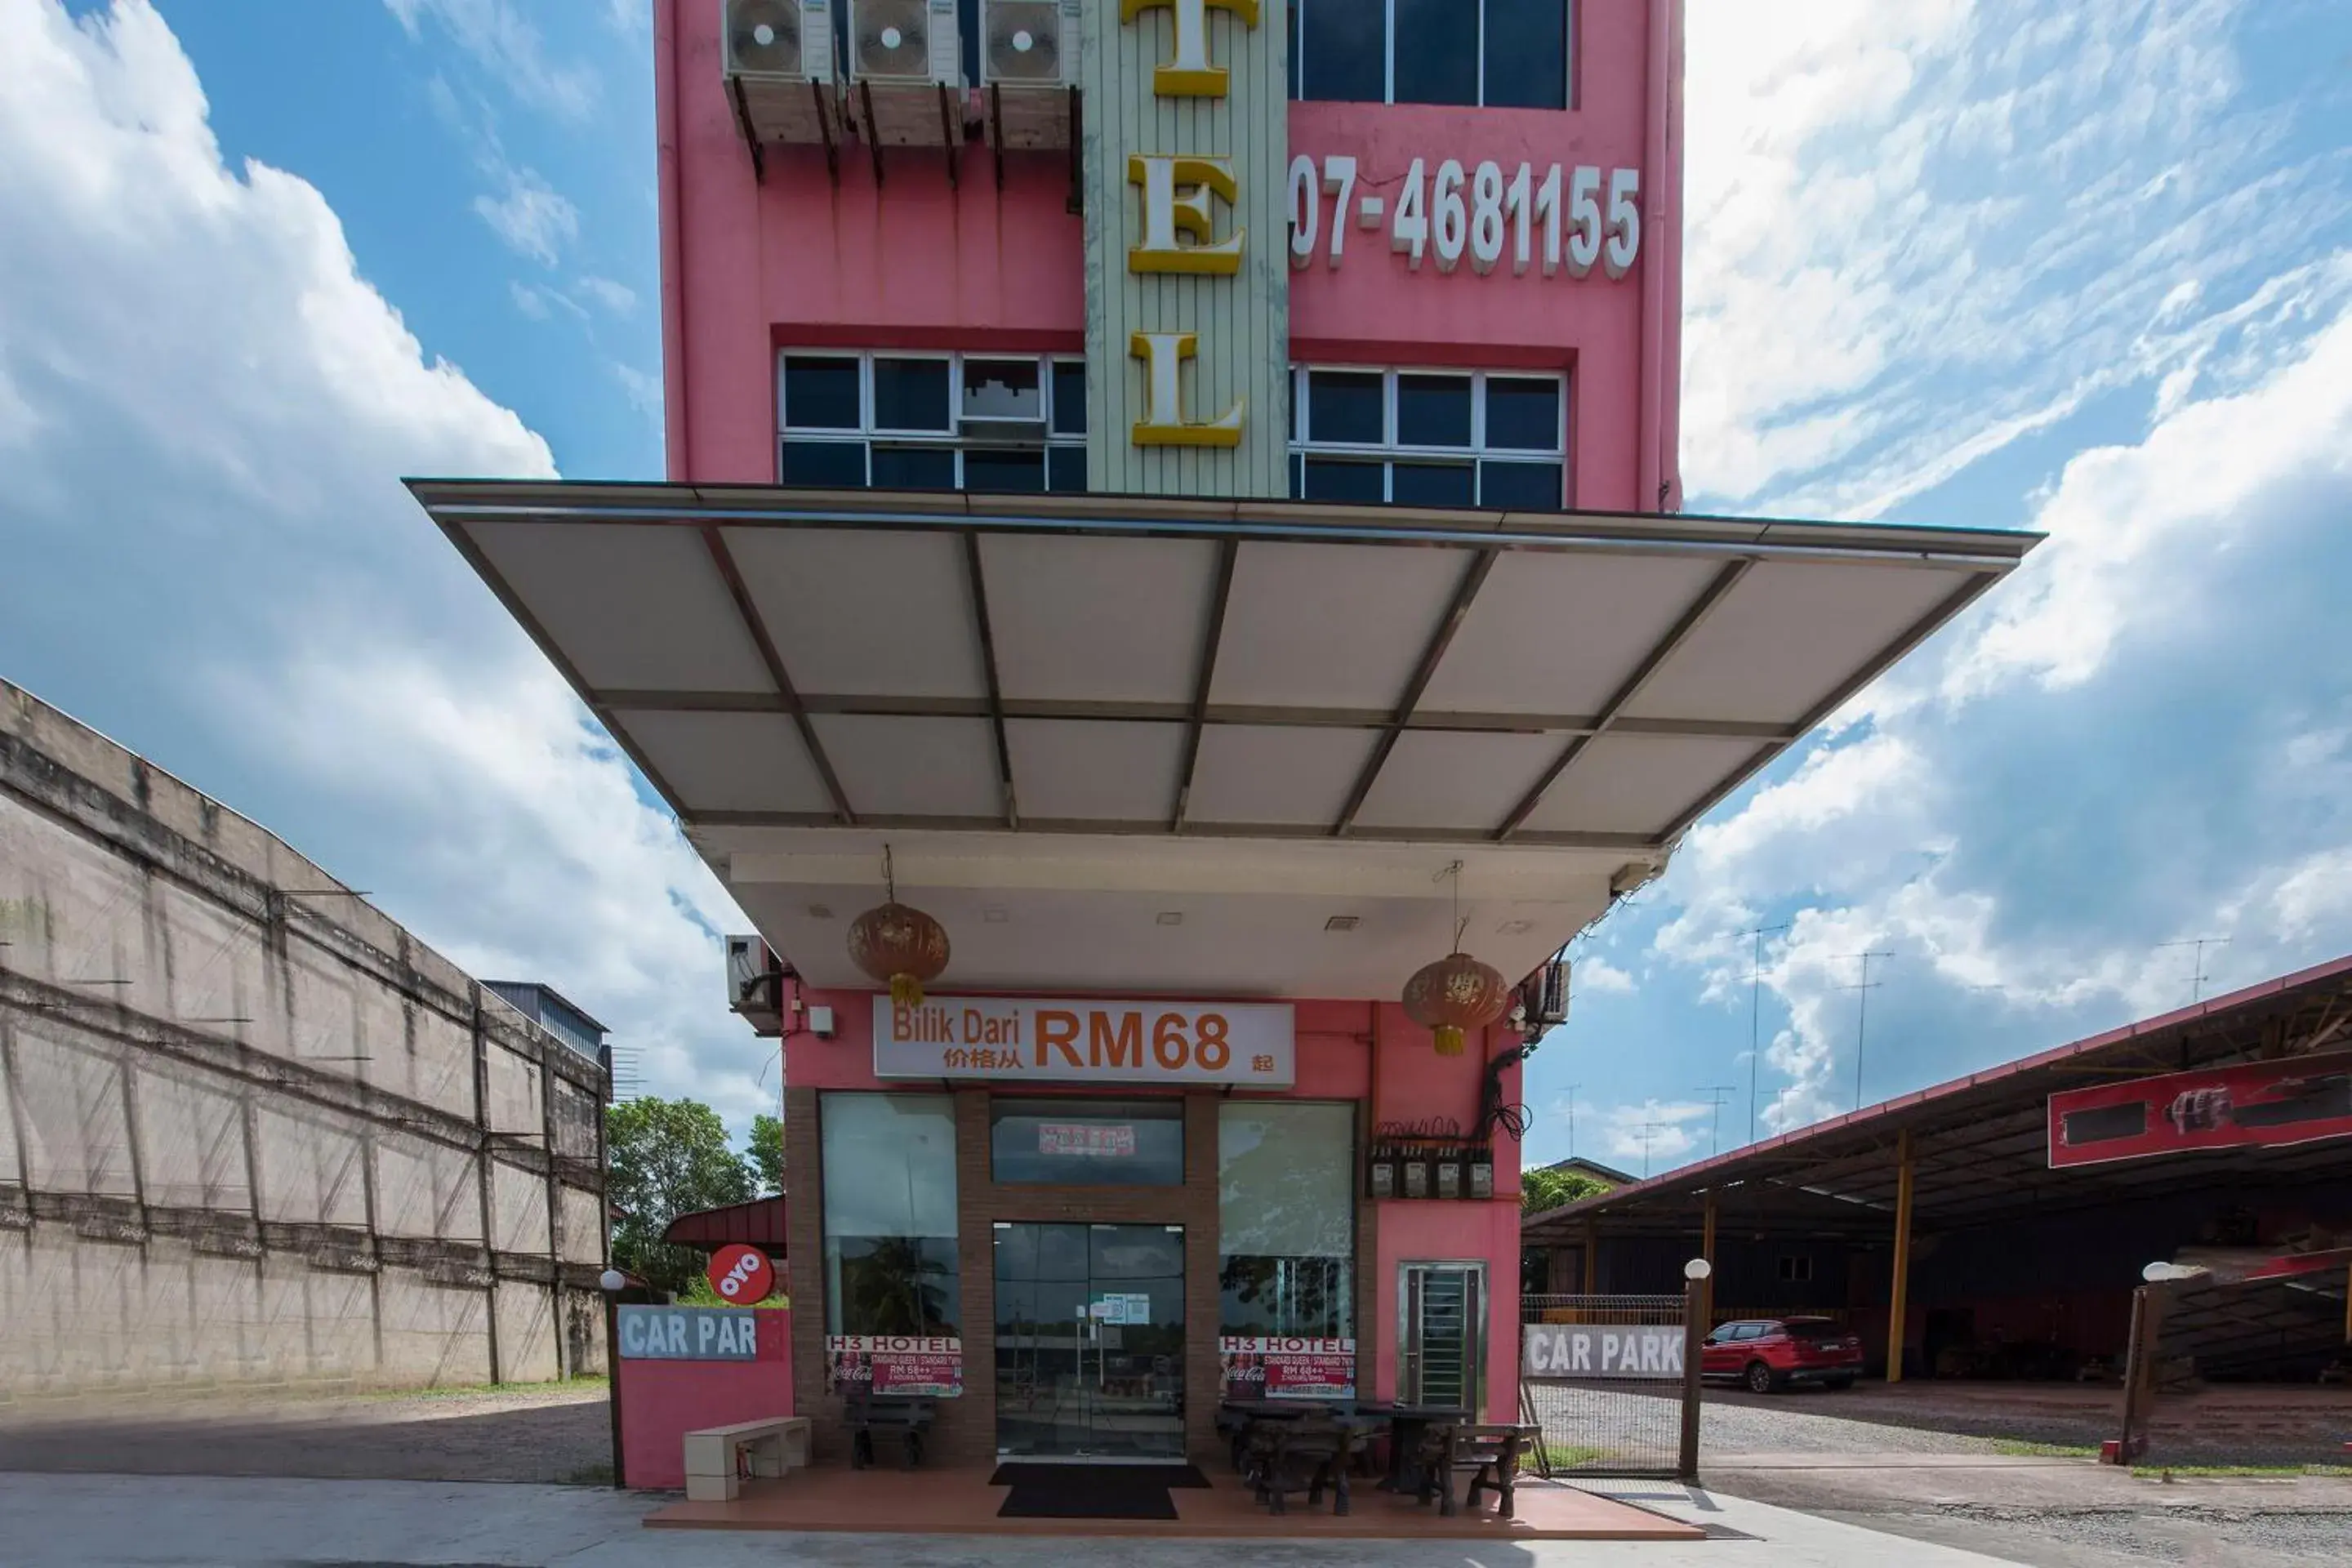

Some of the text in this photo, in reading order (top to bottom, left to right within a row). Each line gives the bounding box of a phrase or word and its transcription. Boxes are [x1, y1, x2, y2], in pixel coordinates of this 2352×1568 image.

[1288, 154, 1640, 279] 07-4681155
[893, 1007, 1019, 1045] Bilik Dari
[1035, 1009, 1231, 1071] RM68
[943, 1048, 1024, 1069] 价格从
[1251, 1054, 1274, 1071] 起
[720, 1254, 760, 1296] OYO
[626, 1313, 689, 1353] CAR
[831, 1336, 960, 1352] H3 HOTEL
[1223, 1337, 1352, 1352] H3 HOTEL
[1530, 1333, 1682, 1373] CAR PARK
